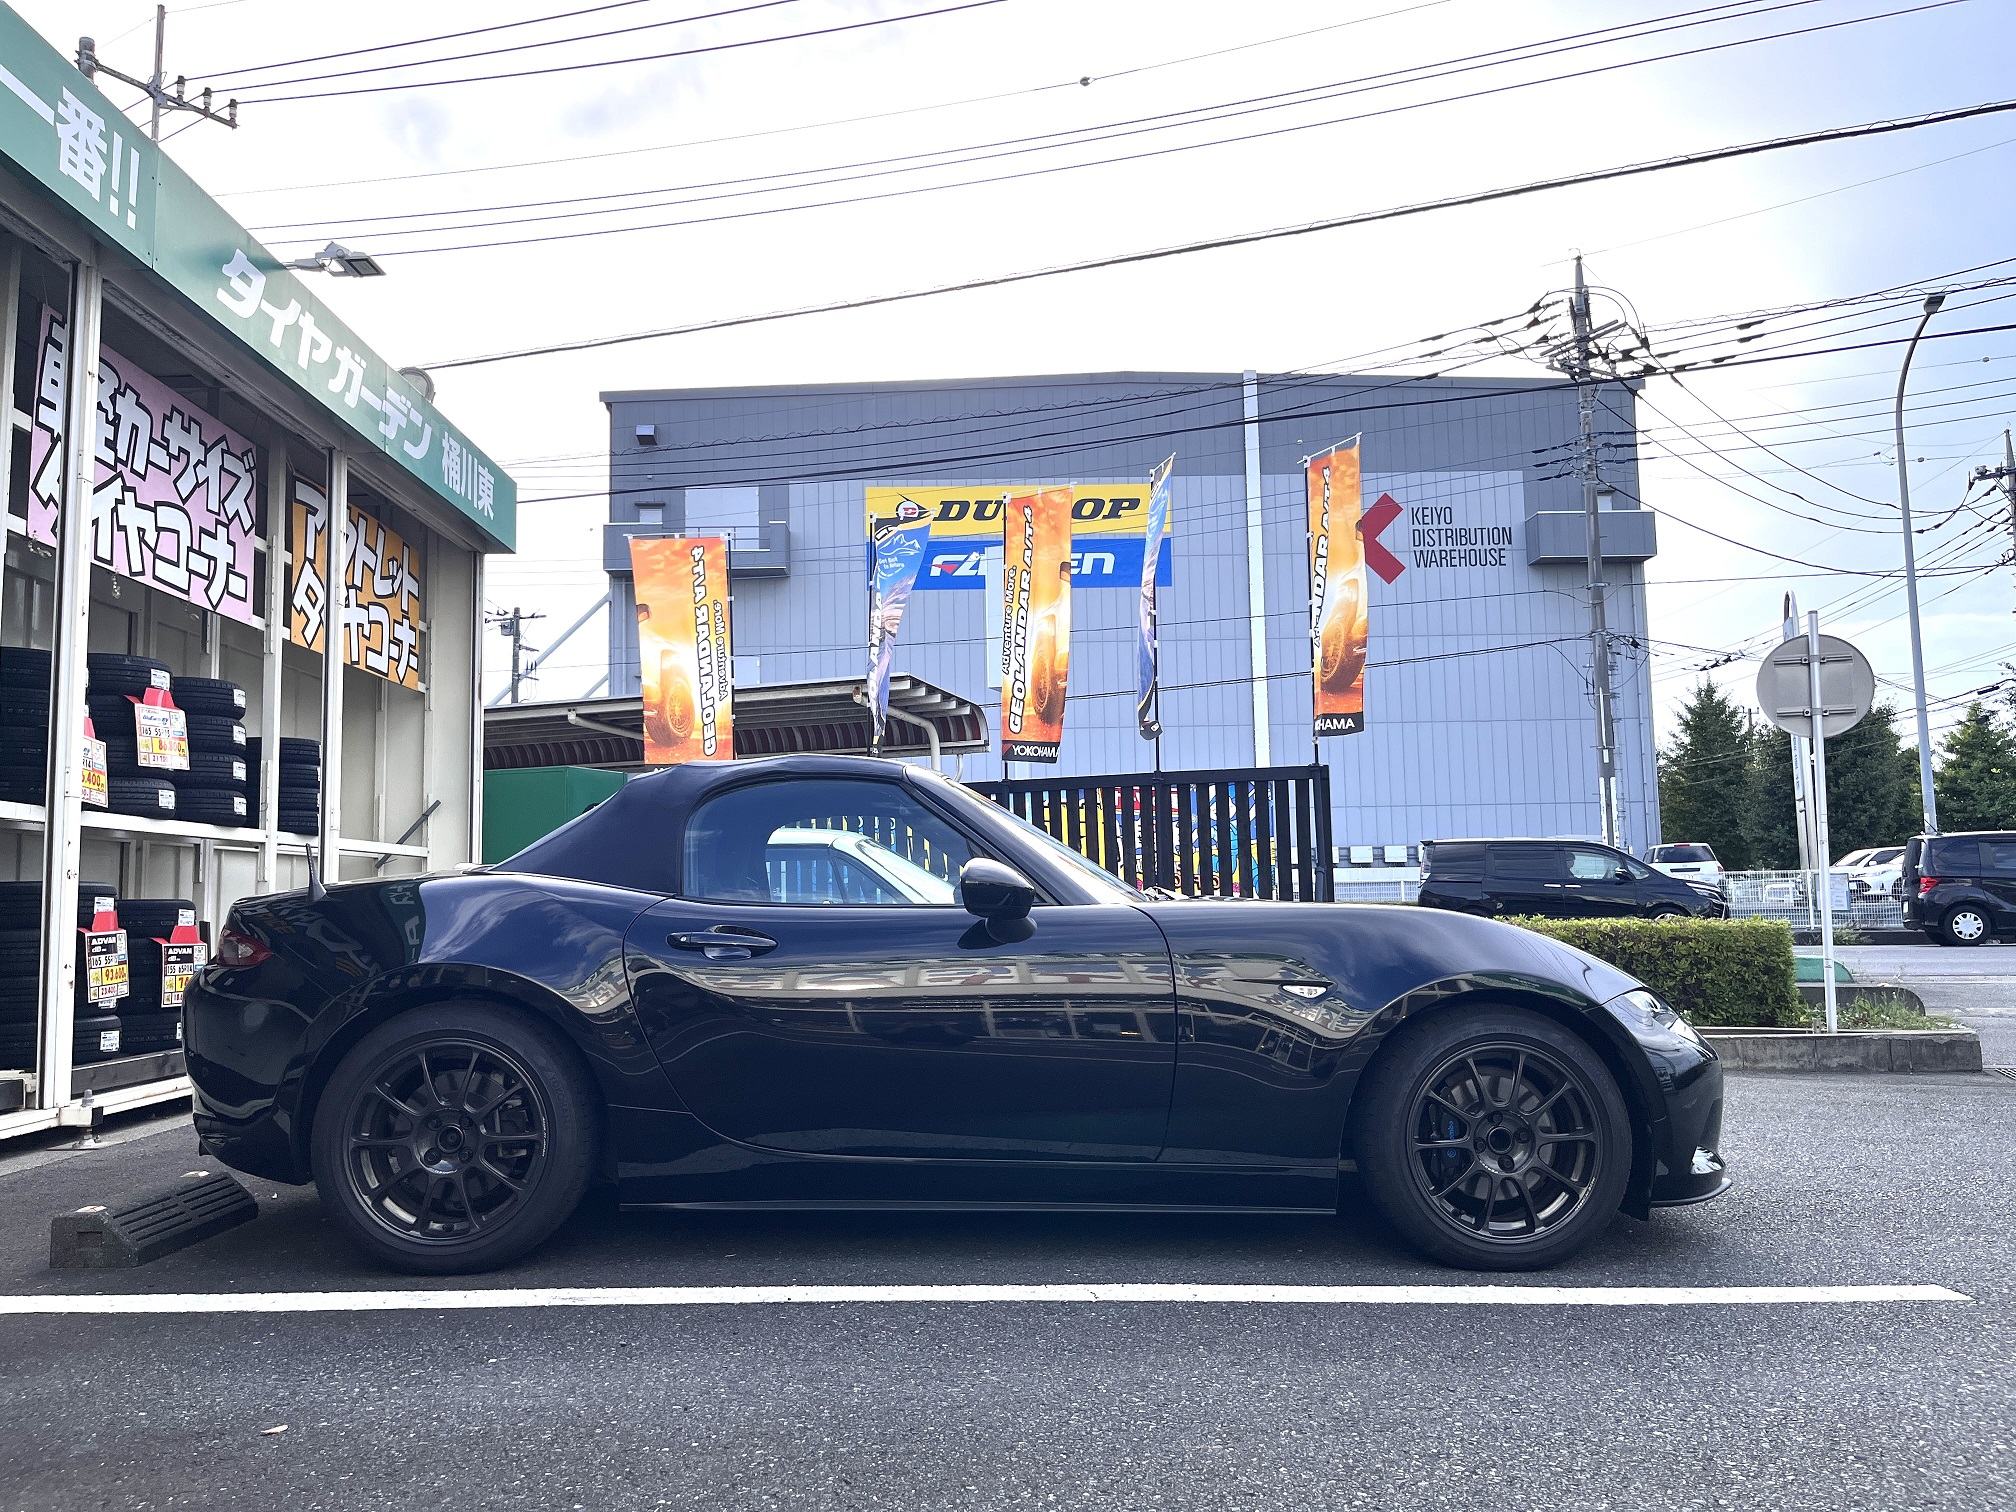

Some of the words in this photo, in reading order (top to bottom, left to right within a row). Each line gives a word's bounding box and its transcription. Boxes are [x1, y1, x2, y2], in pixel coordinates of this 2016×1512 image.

[216, 248, 432, 460] タイヤガーデン
[441, 429, 495, 521] 桶川東
[932, 498, 1141, 522] DUOP
[1411, 506, 1453, 525] KEIYO
[1412, 527, 1512, 548] DISTRIBUTION
[1414, 548, 1507, 569] WAREHOUSE
[1005, 565, 1017, 601] More.
[292, 560, 419, 685] タヤコーナー
[1008, 570, 1032, 734] GEOLANDAR
[1022, 505, 1034, 567] A/T4
[1001, 602, 1014, 675] Adventure
[168, 947, 193, 955] ADVAN
[167, 965, 176, 974] 155
